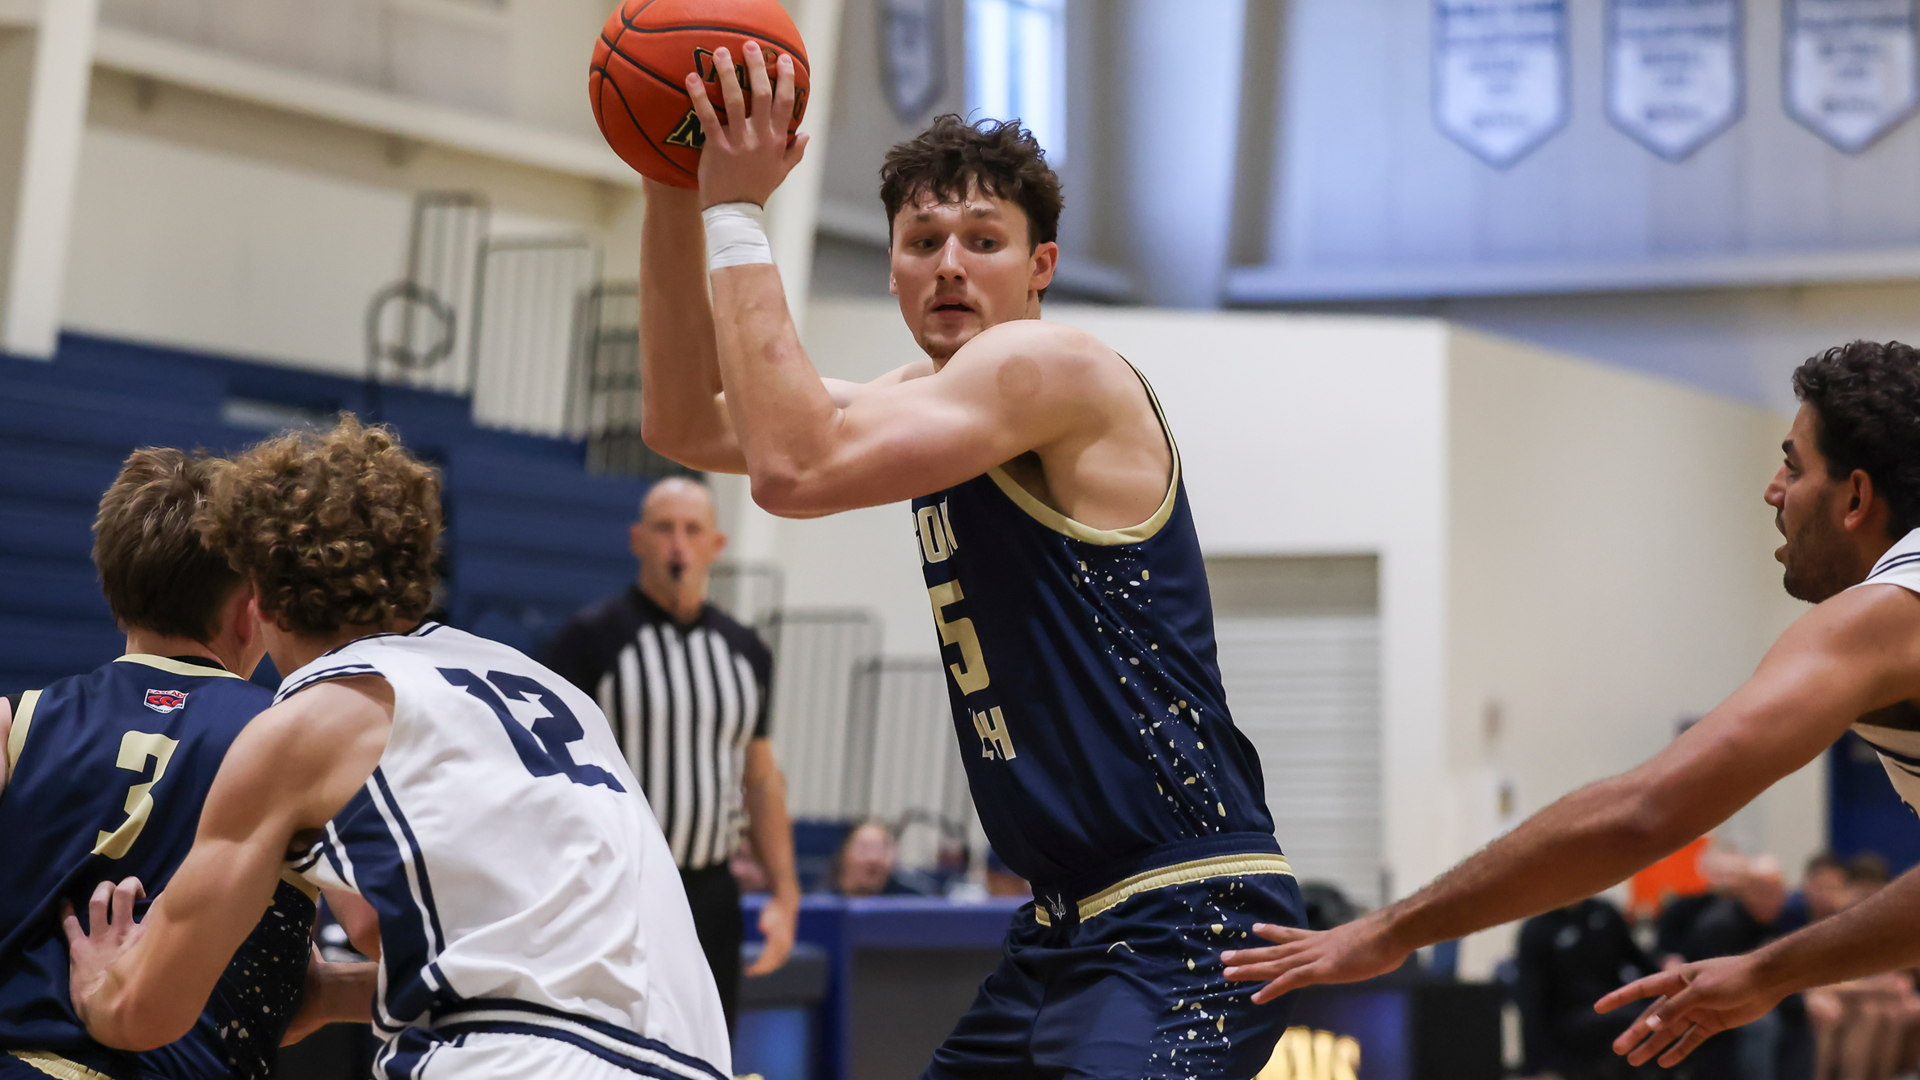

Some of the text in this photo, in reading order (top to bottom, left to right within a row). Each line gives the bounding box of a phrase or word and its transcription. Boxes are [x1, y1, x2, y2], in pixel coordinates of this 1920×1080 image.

[928, 579, 990, 696] 5
[434, 666, 628, 794] 12
[90, 729, 180, 860] 3
